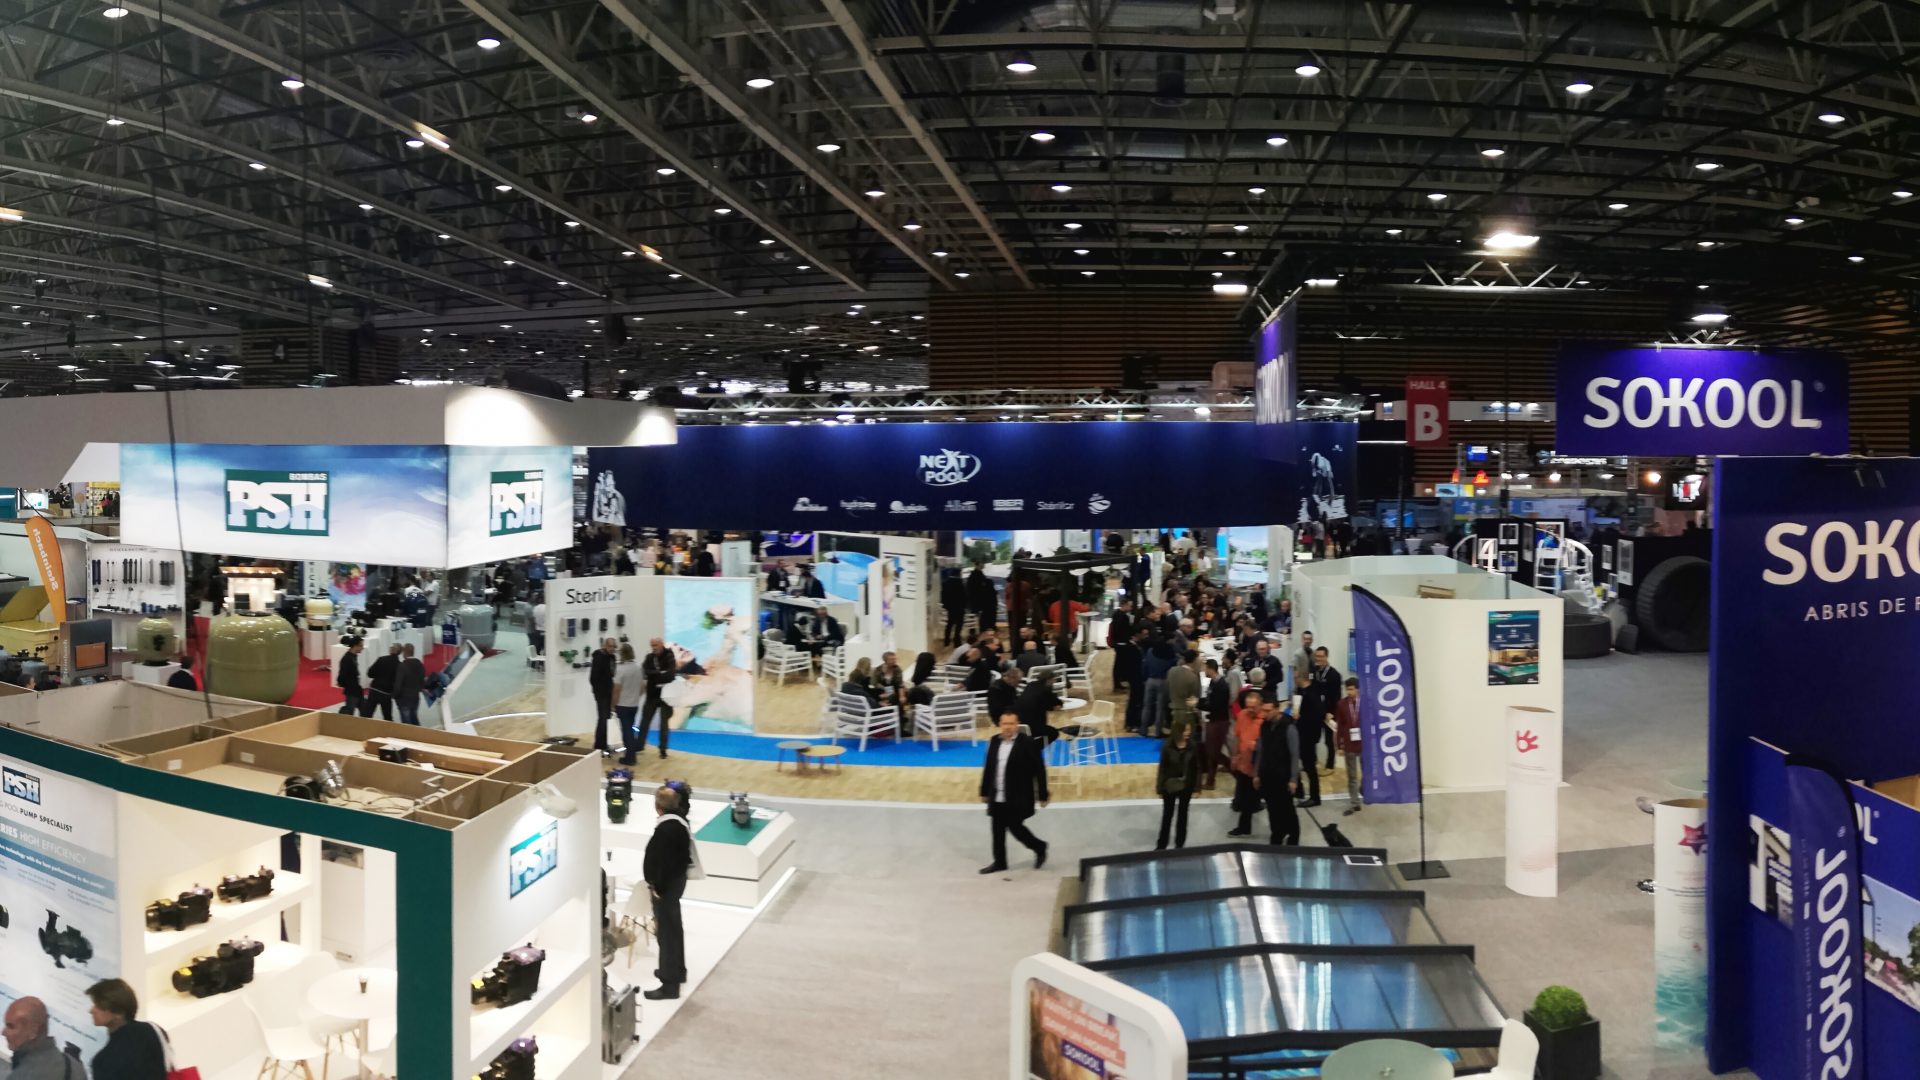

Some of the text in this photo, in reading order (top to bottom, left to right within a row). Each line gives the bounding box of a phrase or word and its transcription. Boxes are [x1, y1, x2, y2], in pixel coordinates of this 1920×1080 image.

[1409, 380, 1447, 390] HALL 4
[1583, 376, 1823, 428] SOKOOL
[1414, 403, 1443, 442] B
[920, 448, 970, 473] NEXT
[925, 470, 968, 483] POOL
[227, 480, 327, 531] PSH
[490, 480, 543, 531] PSH
[1762, 519, 1920, 586] SOK
[1804, 601, 1869, 622] ABRIS
[1879, 597, 1906, 615] DE
[3, 770, 40, 801] PSH
[20, 807, 38, 820] PUMP
[39, 814, 73, 833] SPECIALIST
[0, 823, 18, 838] RIES
[20, 831, 40, 848] HIGH
[41, 839, 88, 866] EFFICIENCY
[511, 829, 558, 897] PSH
